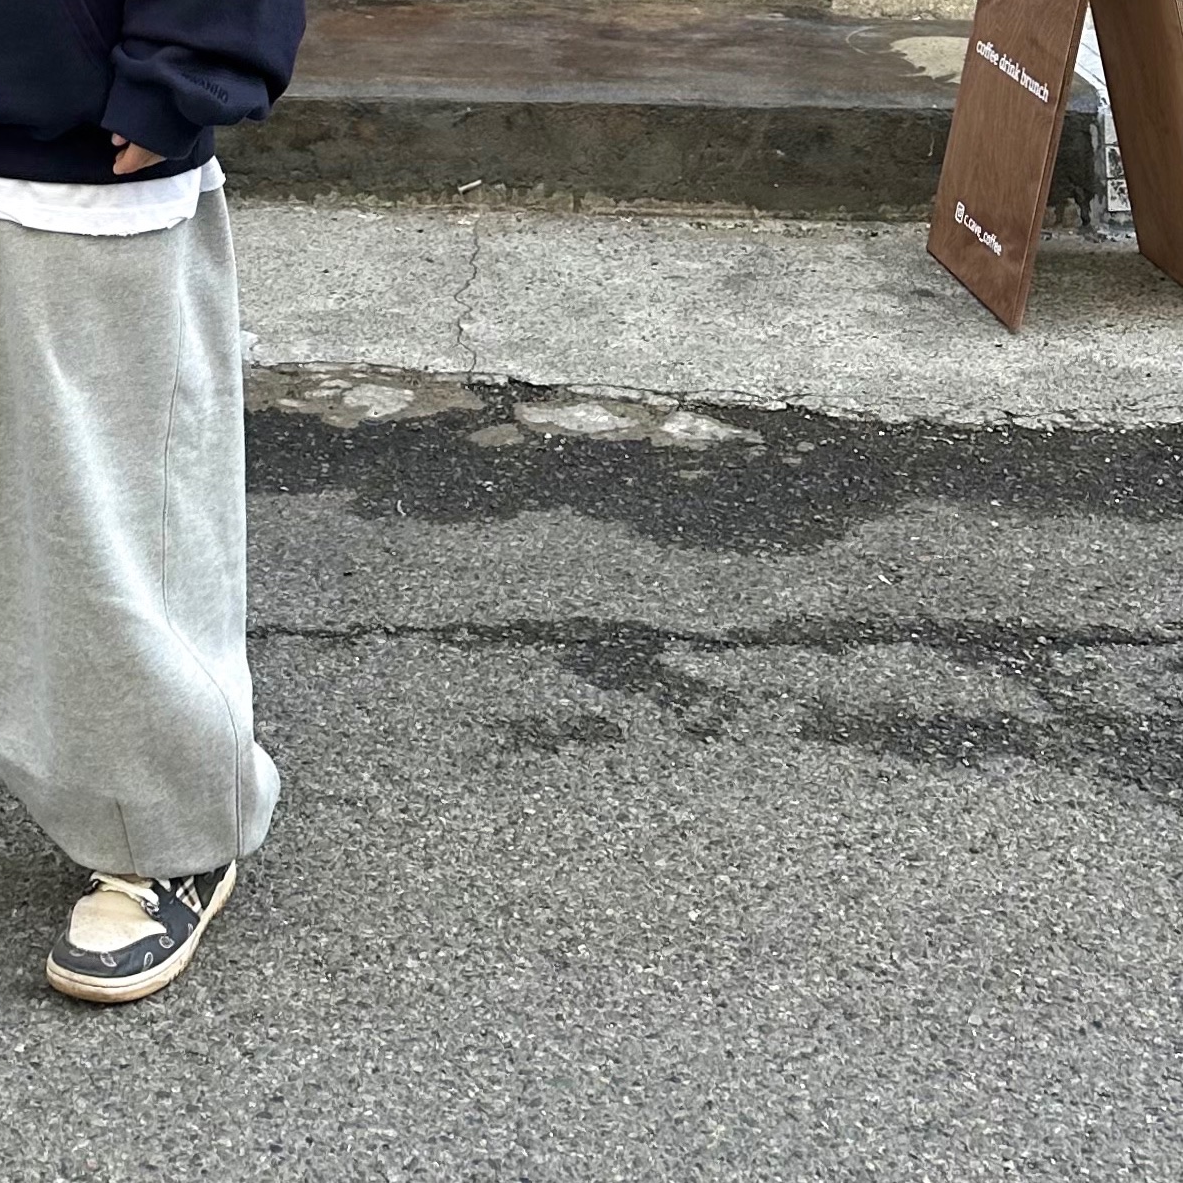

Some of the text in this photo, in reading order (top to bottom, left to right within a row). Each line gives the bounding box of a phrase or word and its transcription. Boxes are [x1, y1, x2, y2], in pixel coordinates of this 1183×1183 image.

[976, 40, 1049, 103] coffee drink brunch
